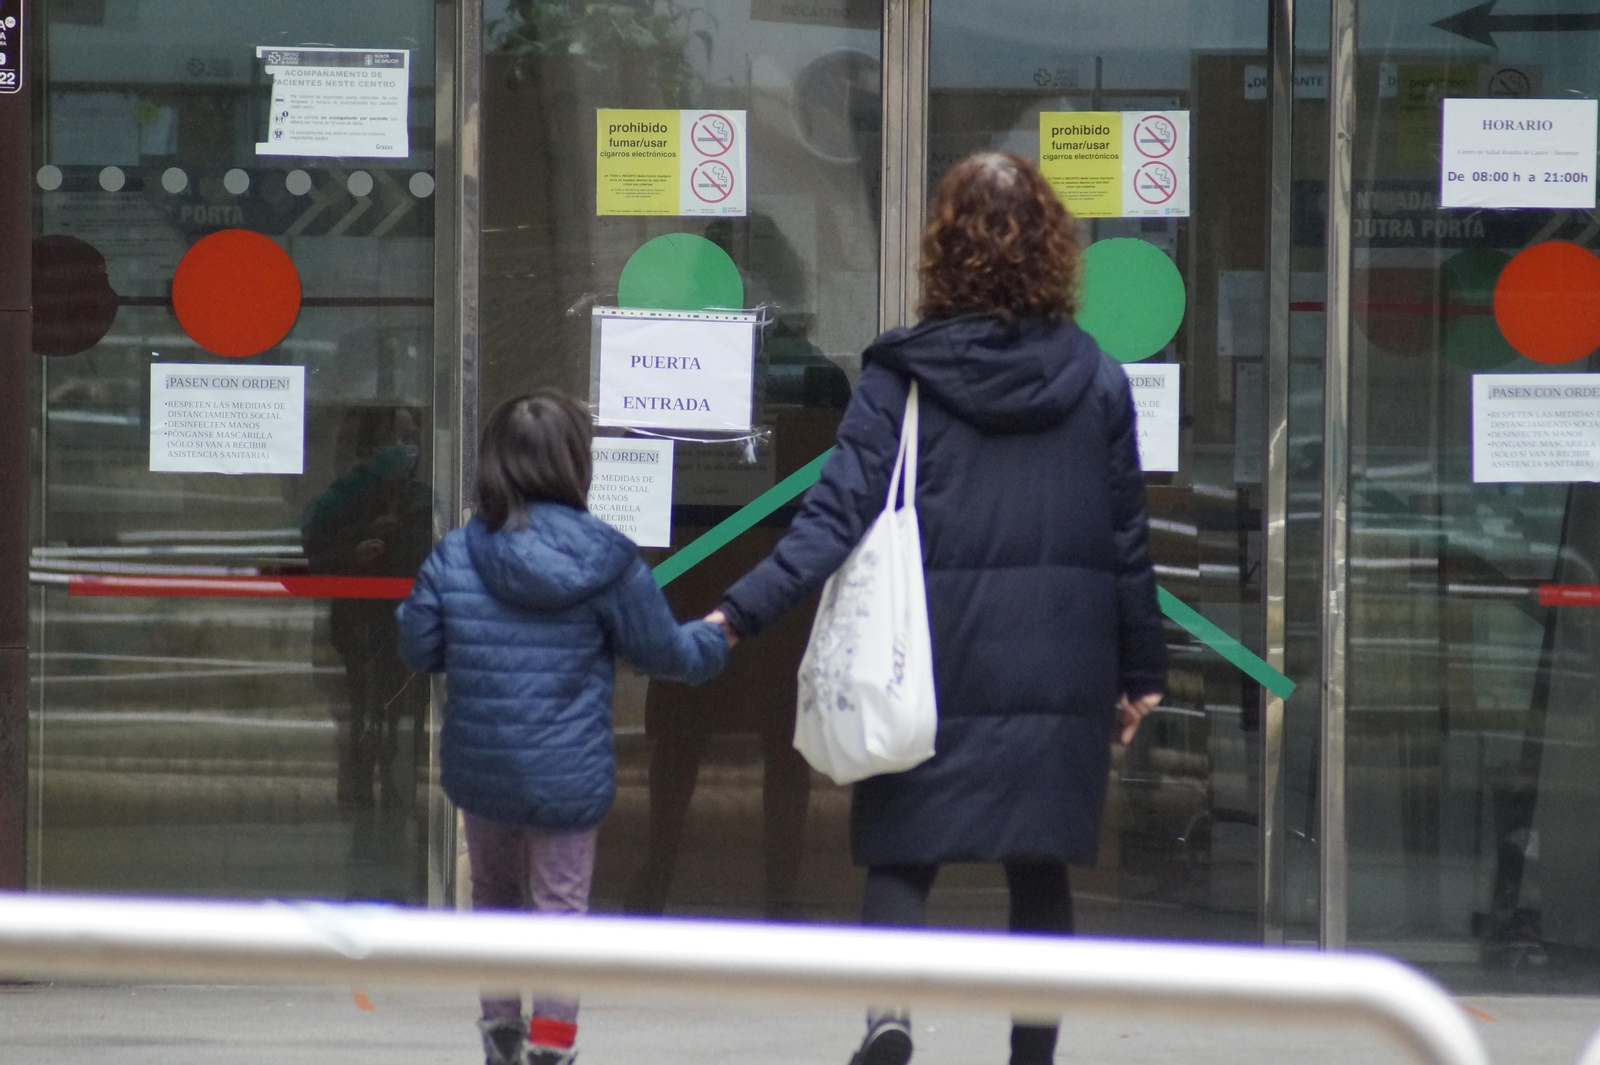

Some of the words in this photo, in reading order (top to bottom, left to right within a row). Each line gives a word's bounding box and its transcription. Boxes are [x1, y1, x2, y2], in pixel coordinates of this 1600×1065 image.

[284, 69, 368, 78] ACOMPAÑAMENTO
[609, 122, 668, 134] prohibido
[1483, 119, 1553, 131] HORARIO
[1052, 125, 1110, 138] prohibido
[609, 138, 668, 148] fumar/usar
[1052, 141, 1110, 150] fumar/usar
[1043, 153, 1072, 161] cigarros
[1448, 172, 1465, 182] De
[1472, 172, 1509, 182] 08:00
[1513, 172, 1520, 182] h
[1544, 172, 1588, 183] 21:00h
[1421, 219, 1485, 238] PORTA
[630, 355, 701, 371] PUERTA
[166, 377, 209, 389] ¡PASEN
[212, 378, 239, 388] CON
[242, 379, 290, 389] ORDEN!
[1128, 377, 1165, 387] RDEN!
[1488, 388, 1531, 399] ¡PASEN
[1535, 388, 1561, 397] CON
[623, 396, 711, 412] ENTRADA
[168, 411, 248, 419] DISTANCIAMIENTO
[250, 411, 281, 419] SOCIAL
[168, 429, 214, 438] PÓNGANSE
[216, 431, 273, 440] MASCARILLA
[167, 440, 193, 449] (SÓLO
[220, 451, 270, 460] SANITARIA)
[612, 451, 659, 462] ORDEN!
